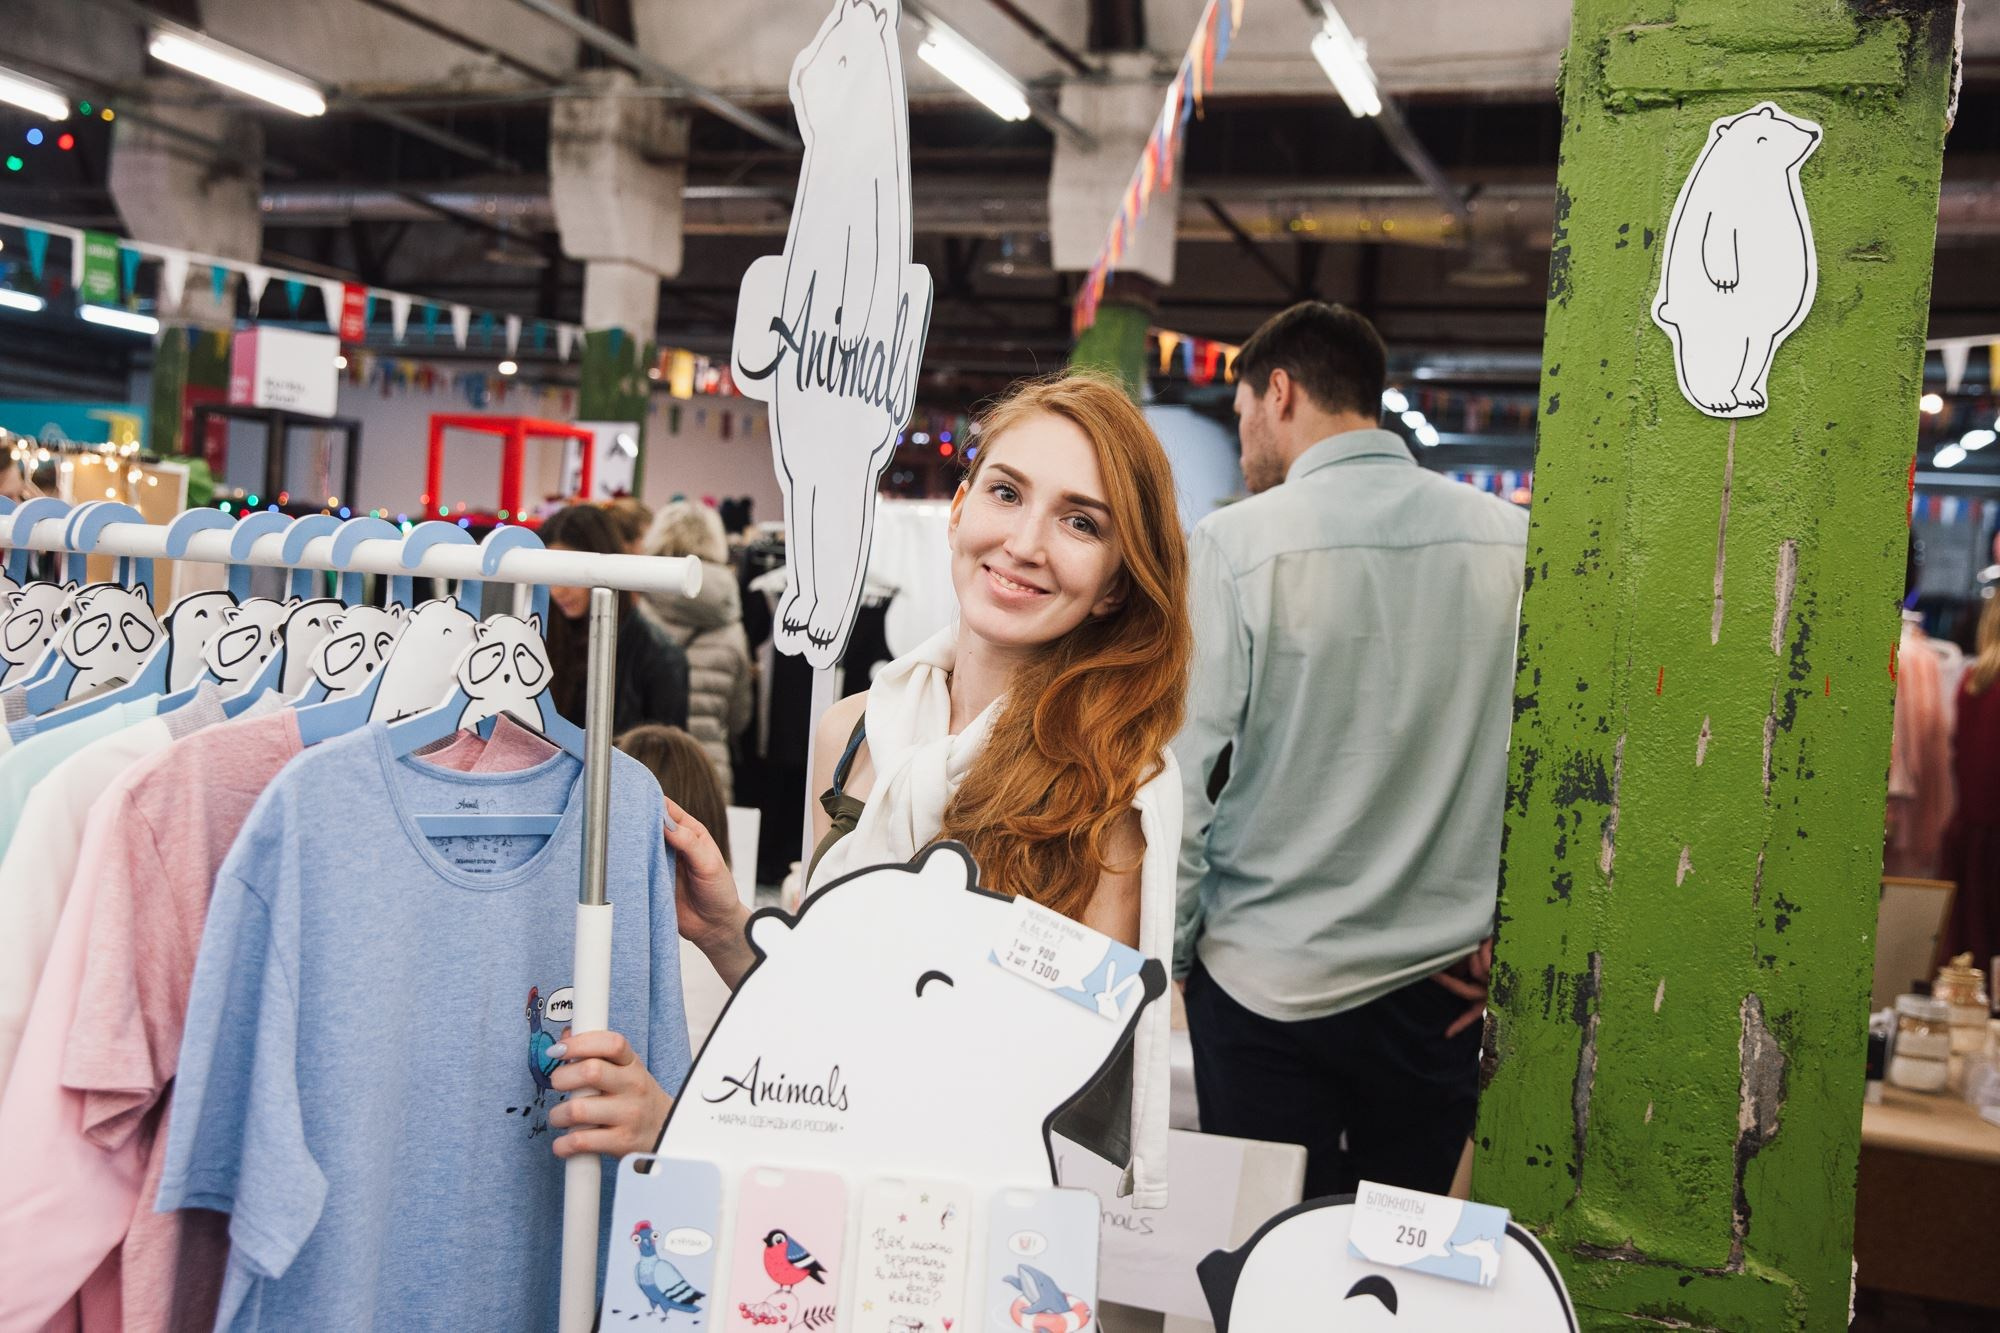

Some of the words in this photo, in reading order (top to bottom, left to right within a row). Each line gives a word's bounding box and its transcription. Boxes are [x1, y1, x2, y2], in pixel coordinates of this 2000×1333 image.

[738, 269, 914, 426] Animals
[1006, 951, 1014, 961] 2
[1031, 959, 1060, 982] 1300
[1037, 945, 1057, 962] 900
[702, 1055, 849, 1112] Animals
[1366, 1191, 1425, 1214] БЛОКНОТЫ
[1396, 1225, 1427, 1248] 250
